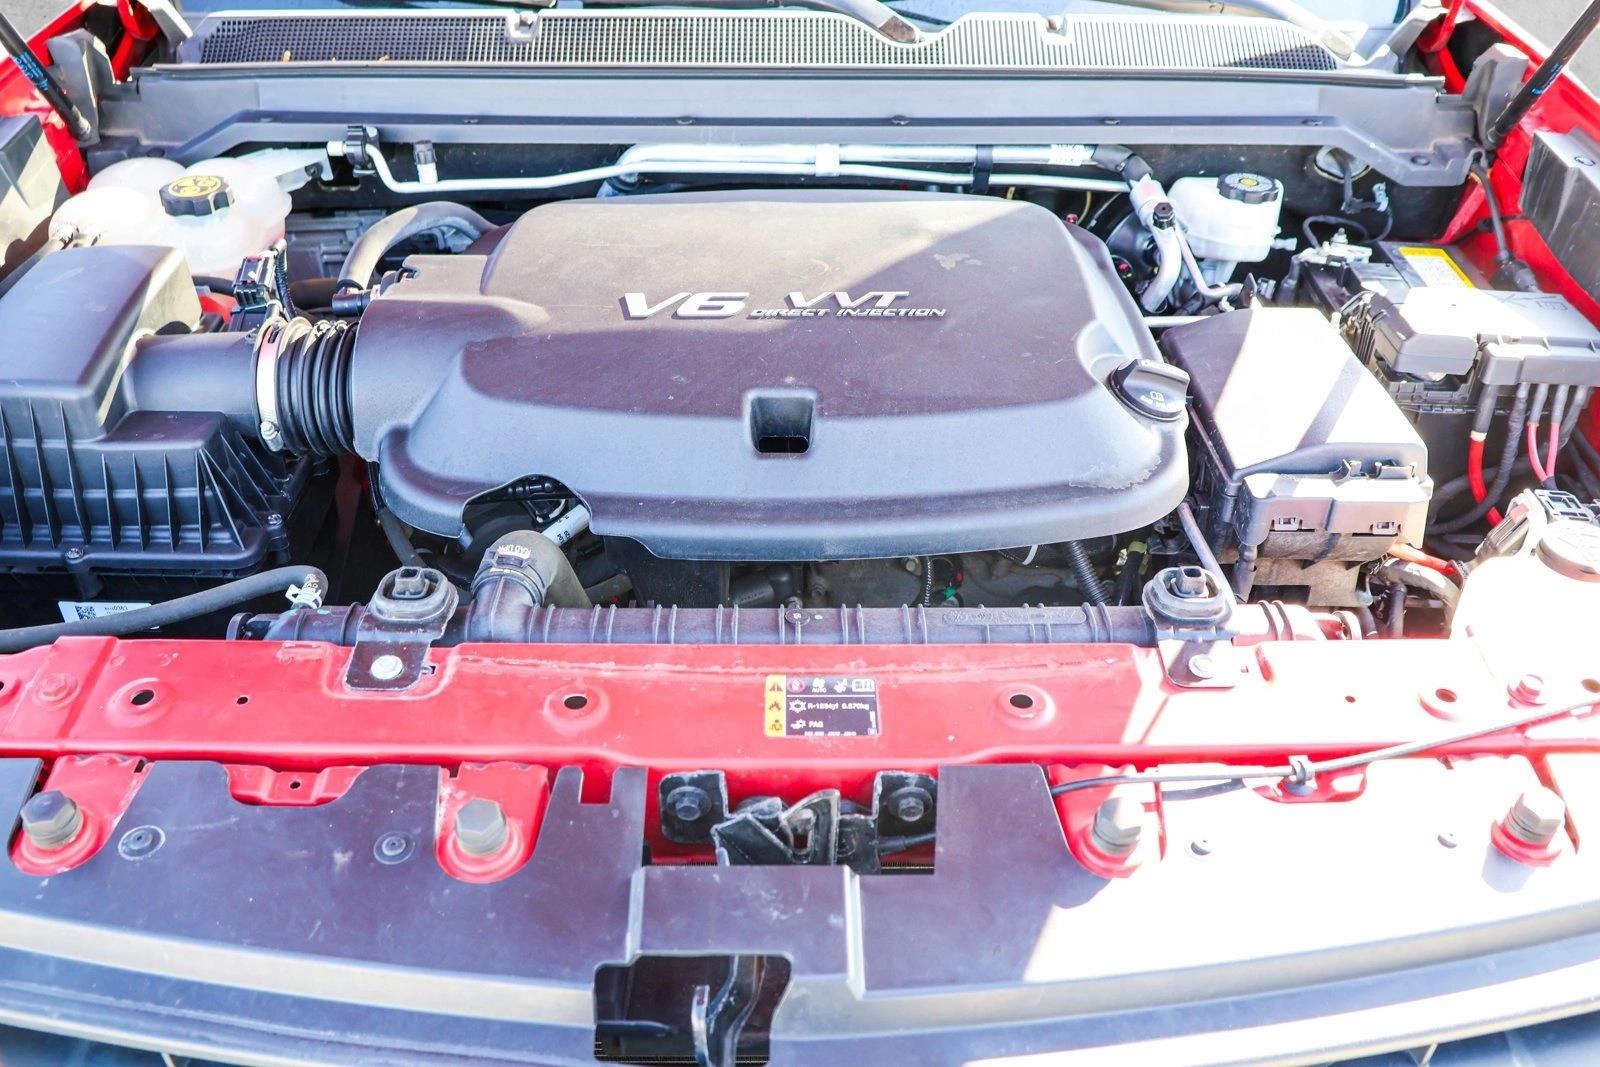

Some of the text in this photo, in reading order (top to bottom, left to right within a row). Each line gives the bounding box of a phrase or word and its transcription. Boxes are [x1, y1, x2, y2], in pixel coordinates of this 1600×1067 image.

[620, 291, 909, 319] V6 VVT
[748, 308, 948, 318] DIRECT INJECTION
